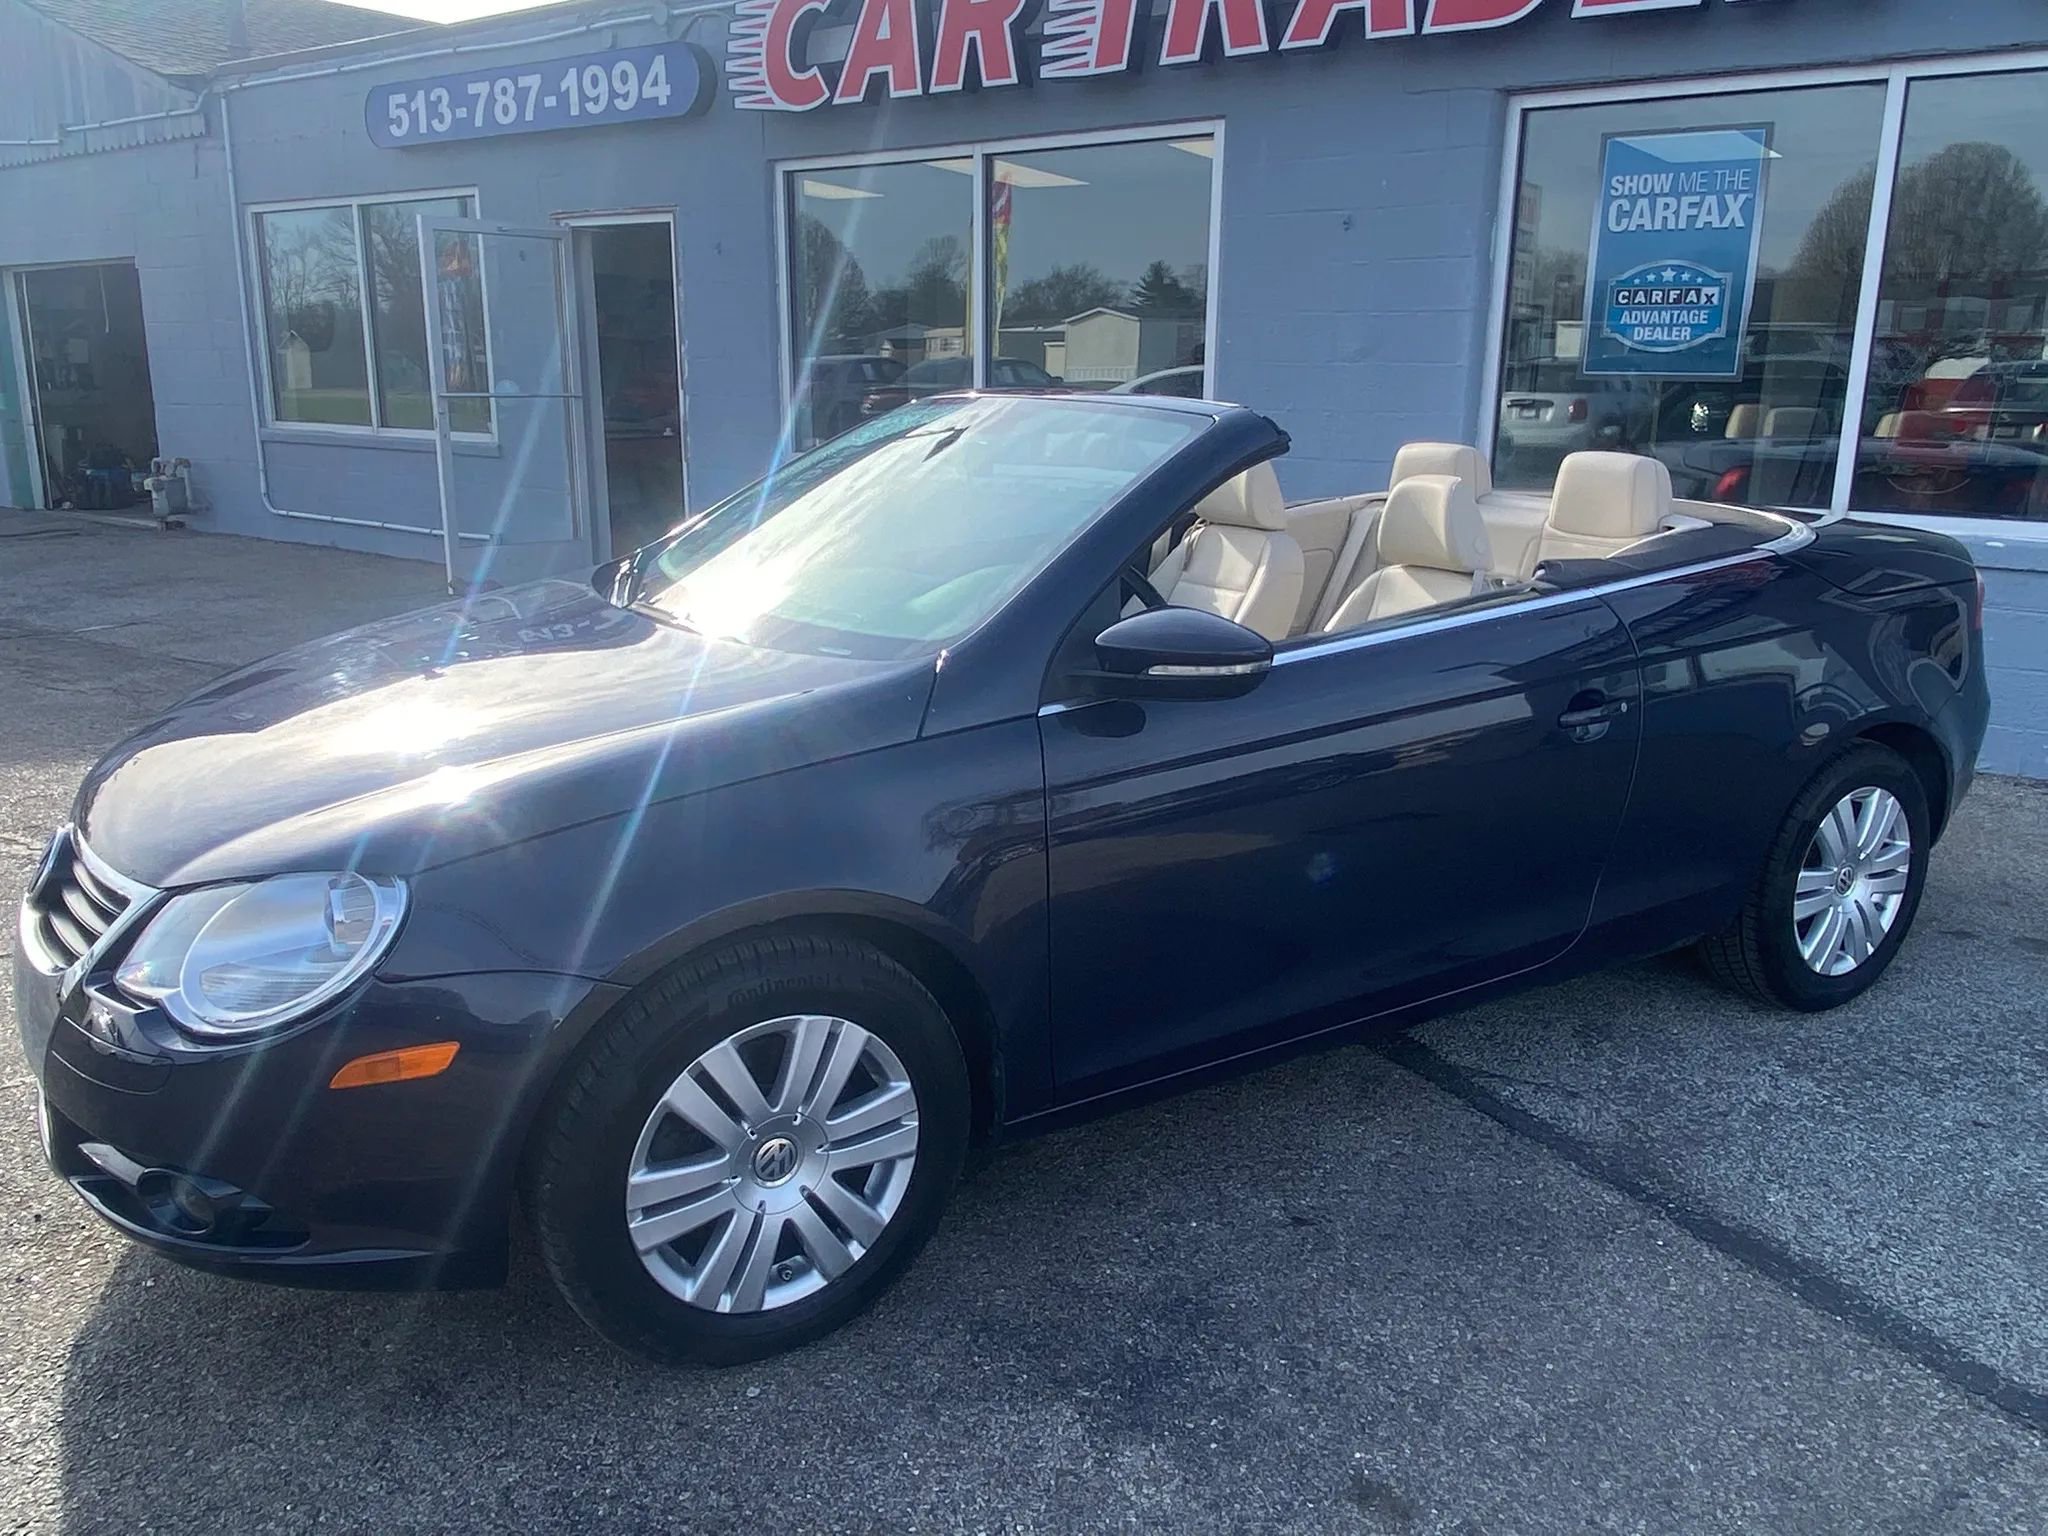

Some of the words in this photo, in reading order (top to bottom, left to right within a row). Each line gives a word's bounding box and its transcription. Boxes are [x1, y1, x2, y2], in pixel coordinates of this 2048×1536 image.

[728, 0, 1019, 111] CAR
[388, 54, 671, 137] 513-787-1994
[1610, 172, 1674, 196] SHOW
[1678, 170, 1709, 193] ME
[1714, 168, 1751, 191] THE
[1607, 193, 1750, 233] CARFAX
[1616, 290, 1716, 305] CARFAX
[1620, 310, 1709, 325] ADVANTAGE
[1633, 326, 1692, 341] DEALER
